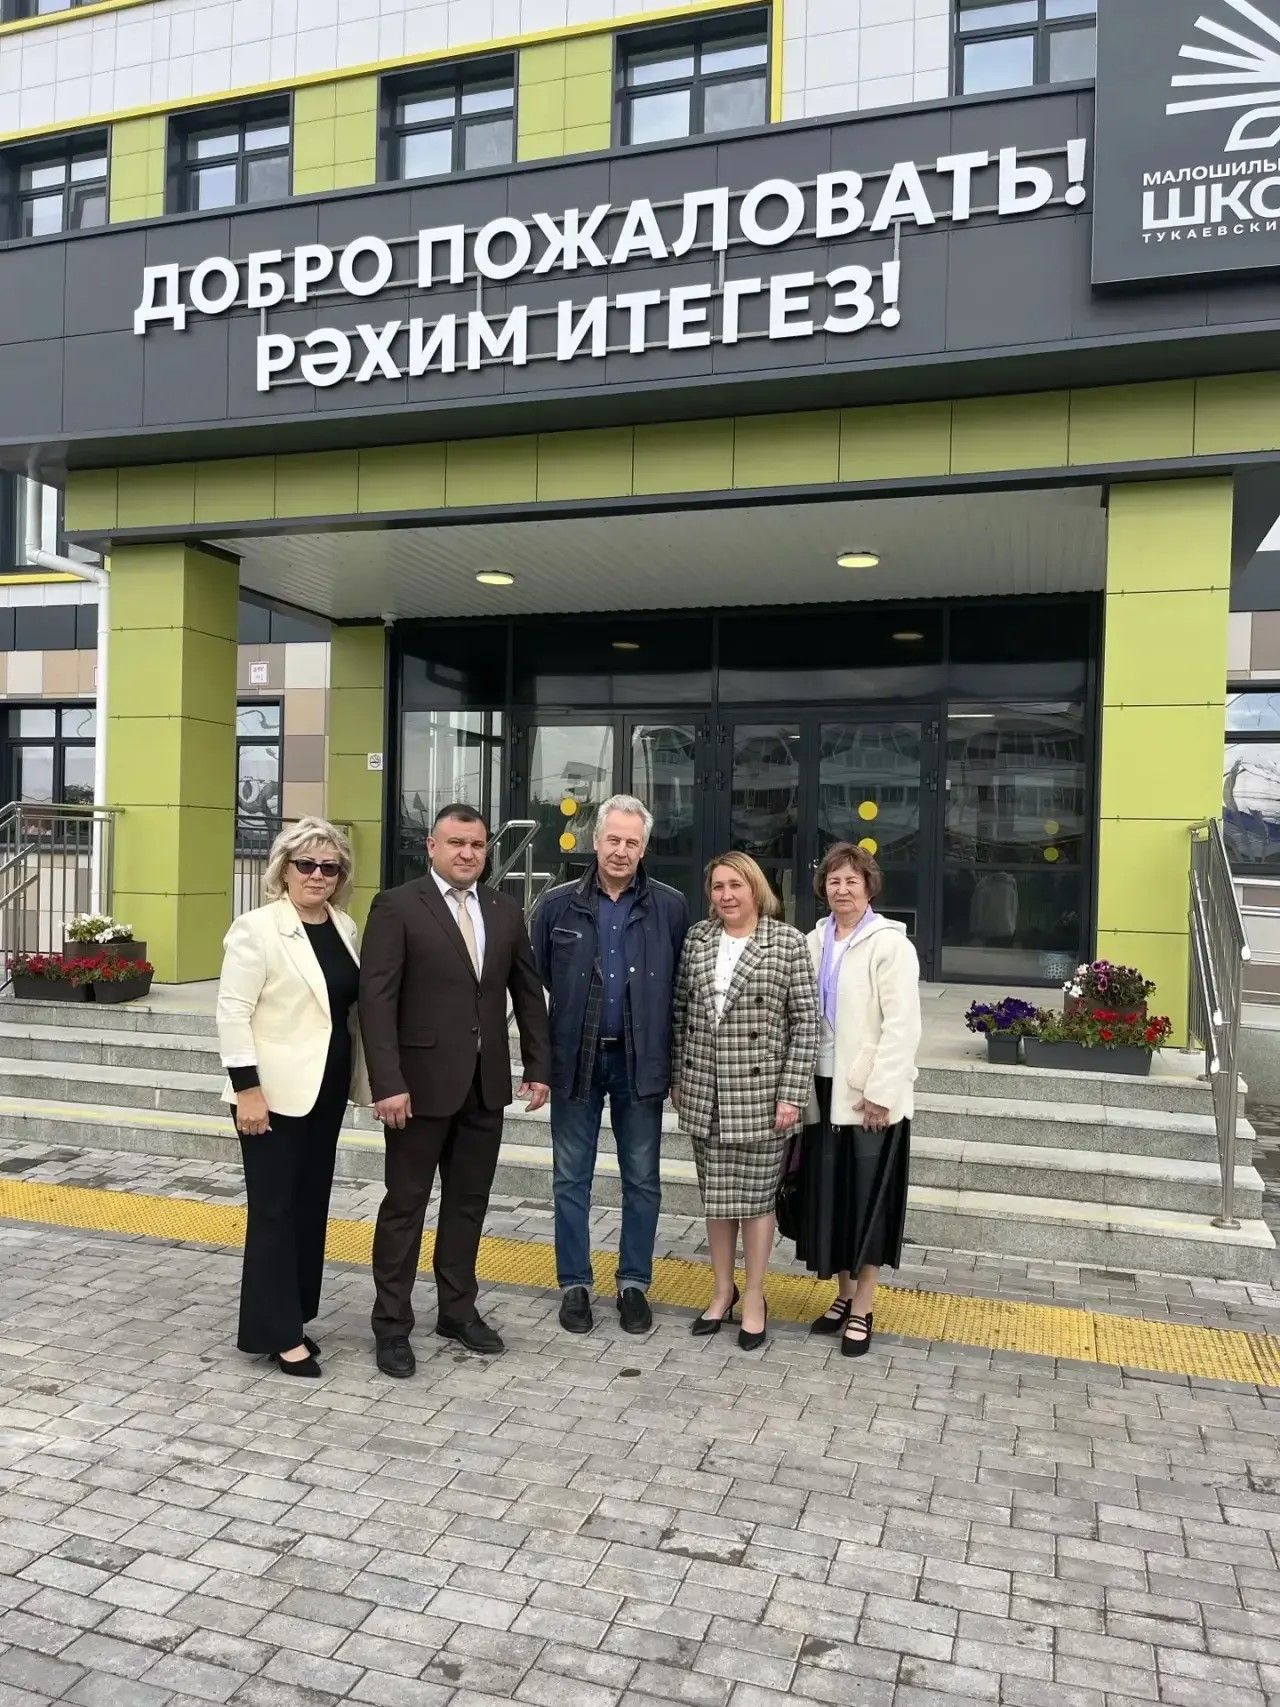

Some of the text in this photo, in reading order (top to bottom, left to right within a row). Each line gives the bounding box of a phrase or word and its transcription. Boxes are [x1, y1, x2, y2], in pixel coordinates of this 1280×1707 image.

[1142, 176, 1280, 230] ШКО
[1143, 157, 1280, 186] МАЛОШИЛЬ
[134, 138, 1087, 334] ДОБРО ПОЖАЛОВАТЬ!
[257, 260, 902, 391] РӘХИМ ИТЕГЕЗ!
